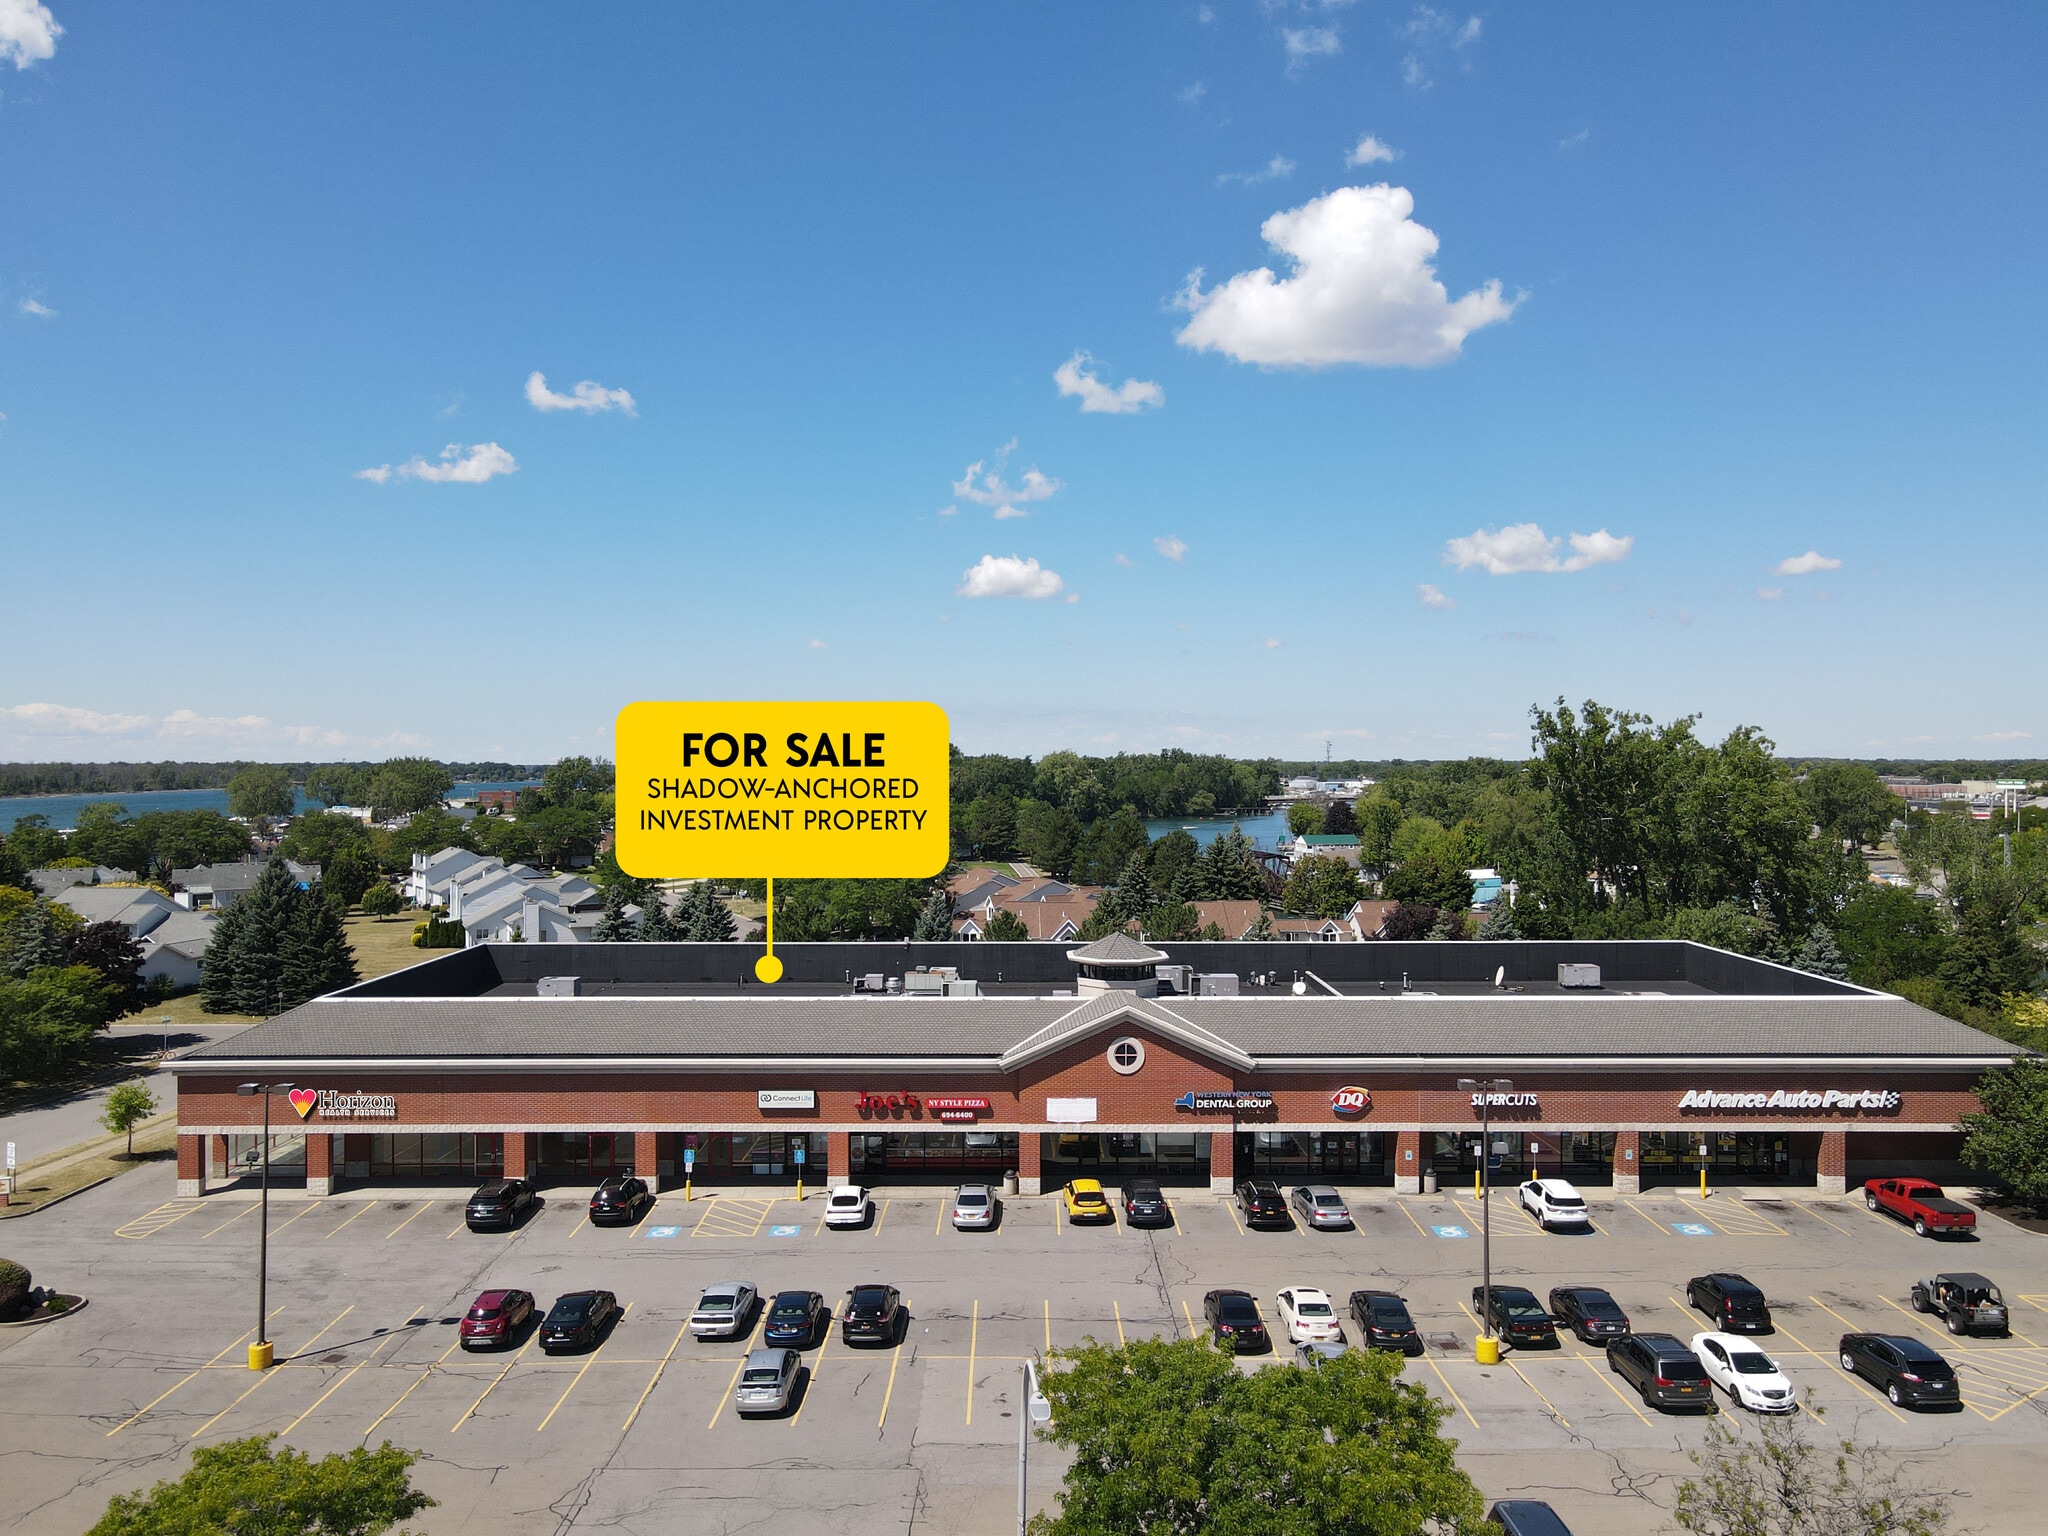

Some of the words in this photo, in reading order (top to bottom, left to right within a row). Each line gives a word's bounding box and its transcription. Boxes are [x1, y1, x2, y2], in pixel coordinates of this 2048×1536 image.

[318, 1090, 395, 1109] Horizon
[855, 1090, 918, 1110] Joe's
[1196, 1100, 1234, 1108] DENTAL
[1236, 1100, 1272, 1108] GROUP
[1338, 1093, 1364, 1107] DQ
[1471, 1094, 1537, 1106] SUPERCUTS
[1678, 1090, 1767, 1108] Advance
[1767, 1090, 1822, 1108] Auto
